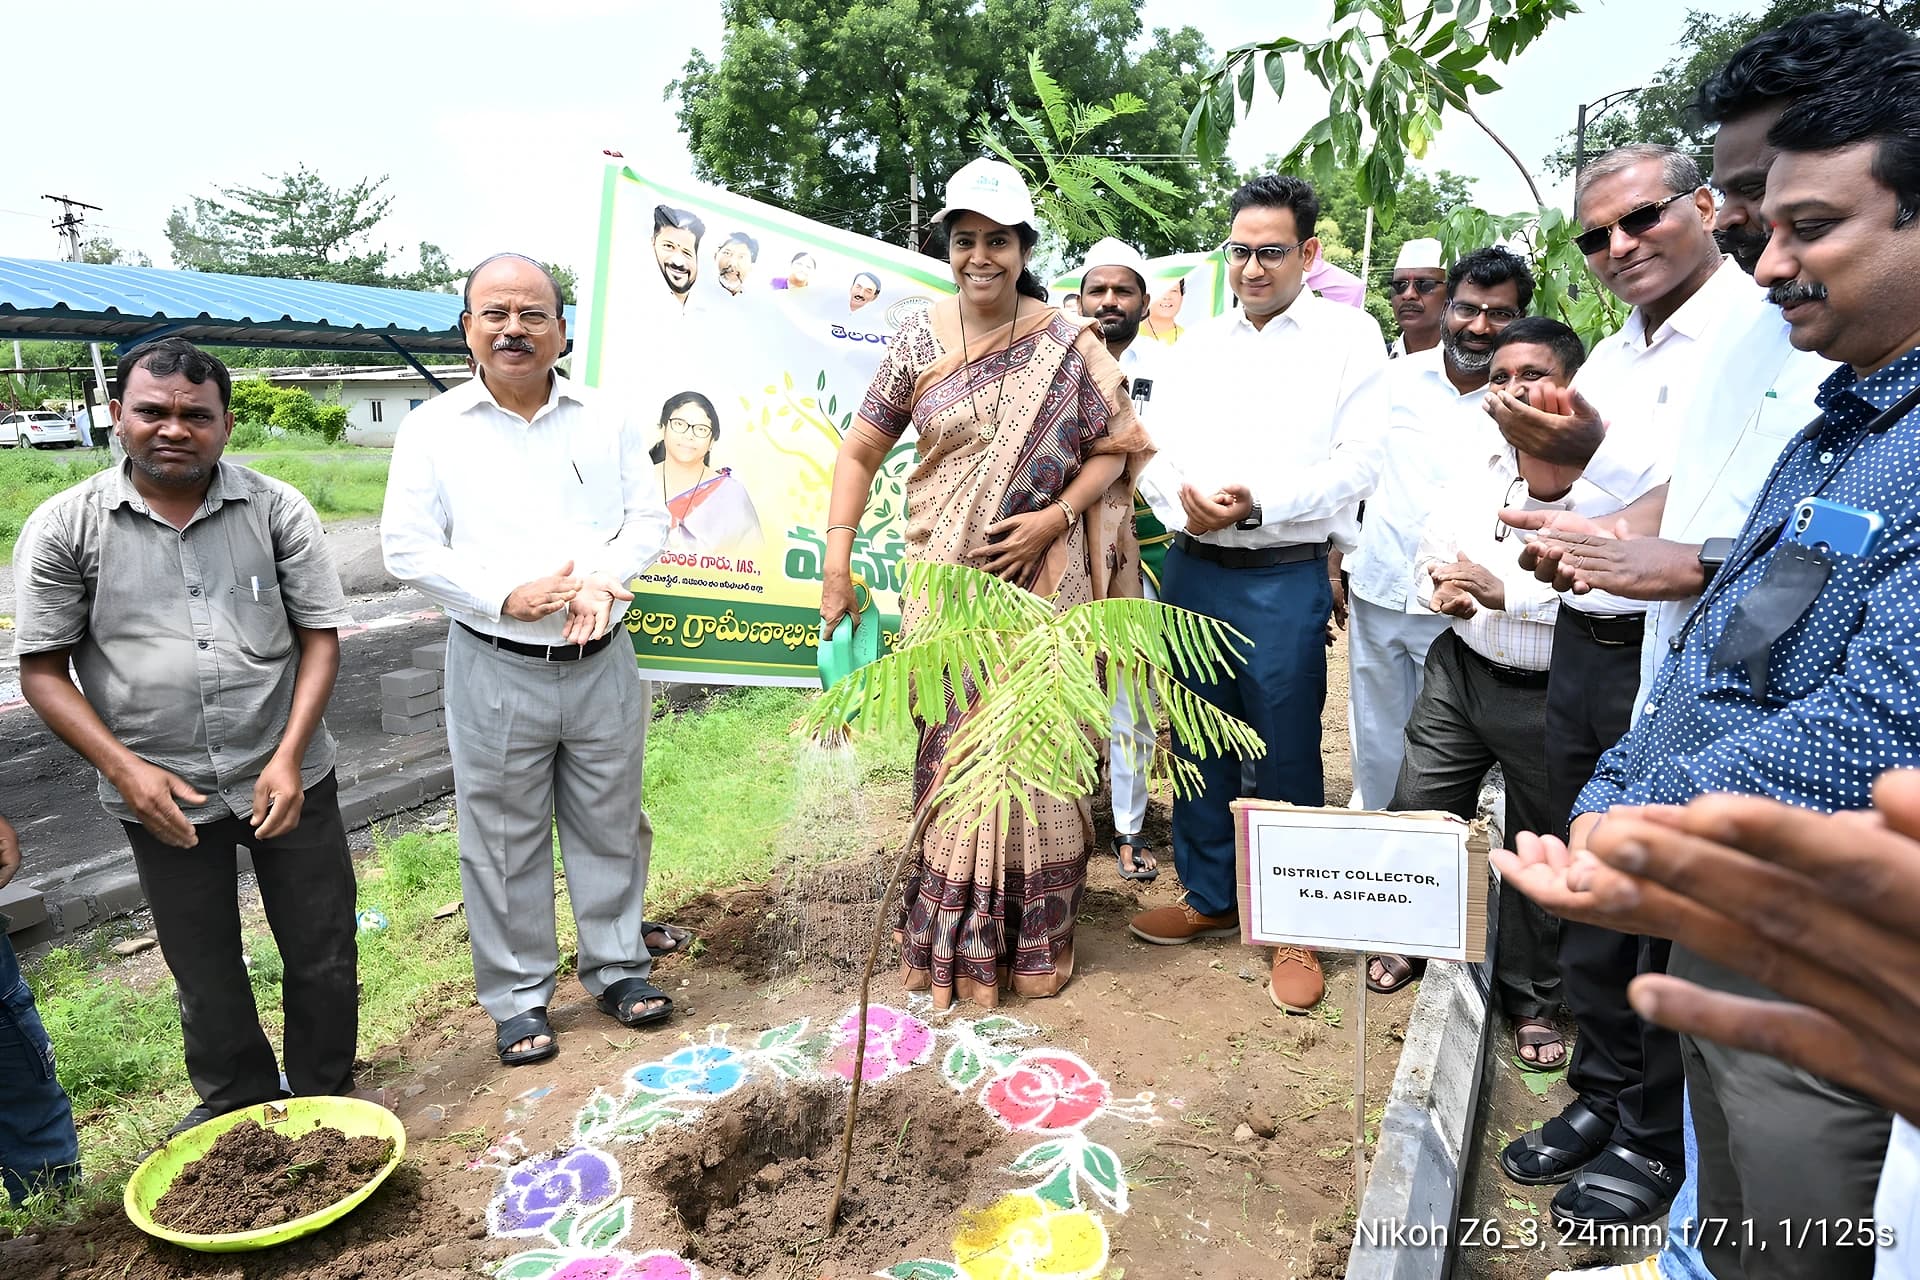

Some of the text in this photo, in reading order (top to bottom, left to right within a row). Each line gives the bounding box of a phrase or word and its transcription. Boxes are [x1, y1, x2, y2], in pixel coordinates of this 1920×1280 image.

[1272, 866, 1440, 887] DISTRICT COLLECTOR,
[1299, 888, 1412, 904] K.B. ASIFABAD.
